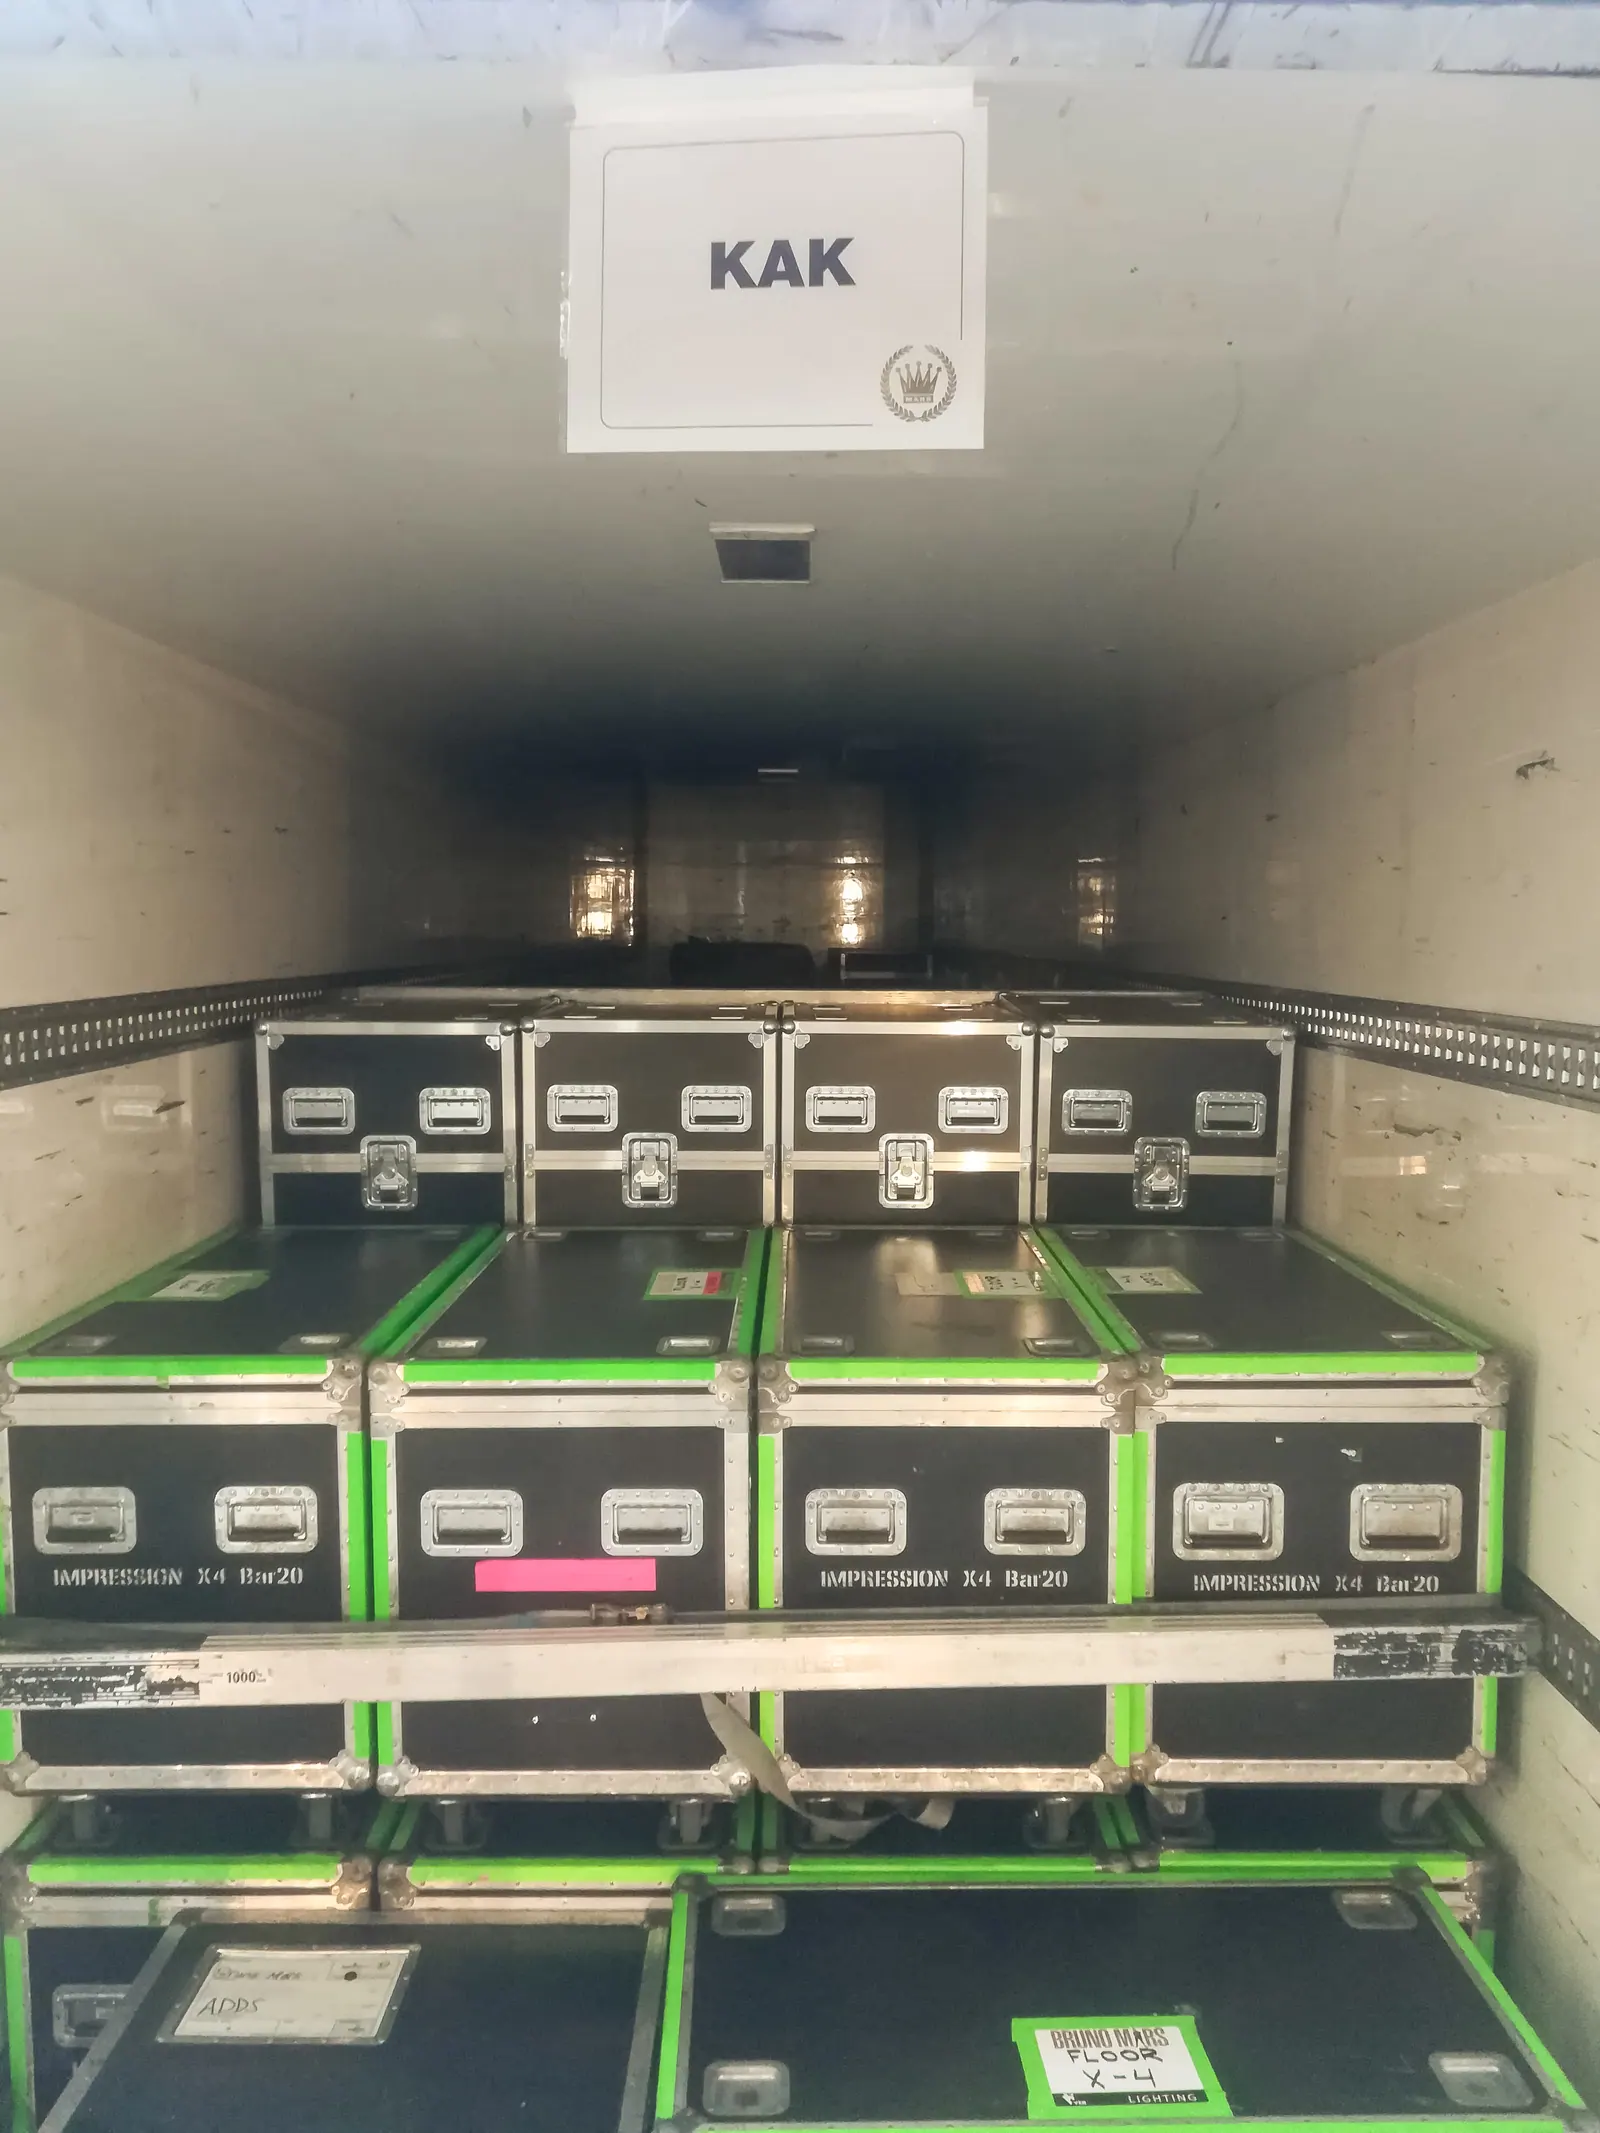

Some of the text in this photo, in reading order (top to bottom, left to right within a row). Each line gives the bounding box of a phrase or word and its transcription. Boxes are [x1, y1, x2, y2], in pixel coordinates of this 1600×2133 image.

[710, 237, 857, 290] KAK
[53, 1566, 304, 1586] IMPRESSION X4 Bar20
[820, 1569, 1069, 1588] IMPRESSION X4 Bar20
[1193, 1573, 1439, 1592] IMPRESSION X4 Bar20
[197, 1997, 265, 2016] ADDS
[1050, 2026, 1170, 2049] BRUNO MARS
[1066, 2049, 1163, 2064] FLOOR
[1128, 2093, 1198, 2104] LIGHTING
